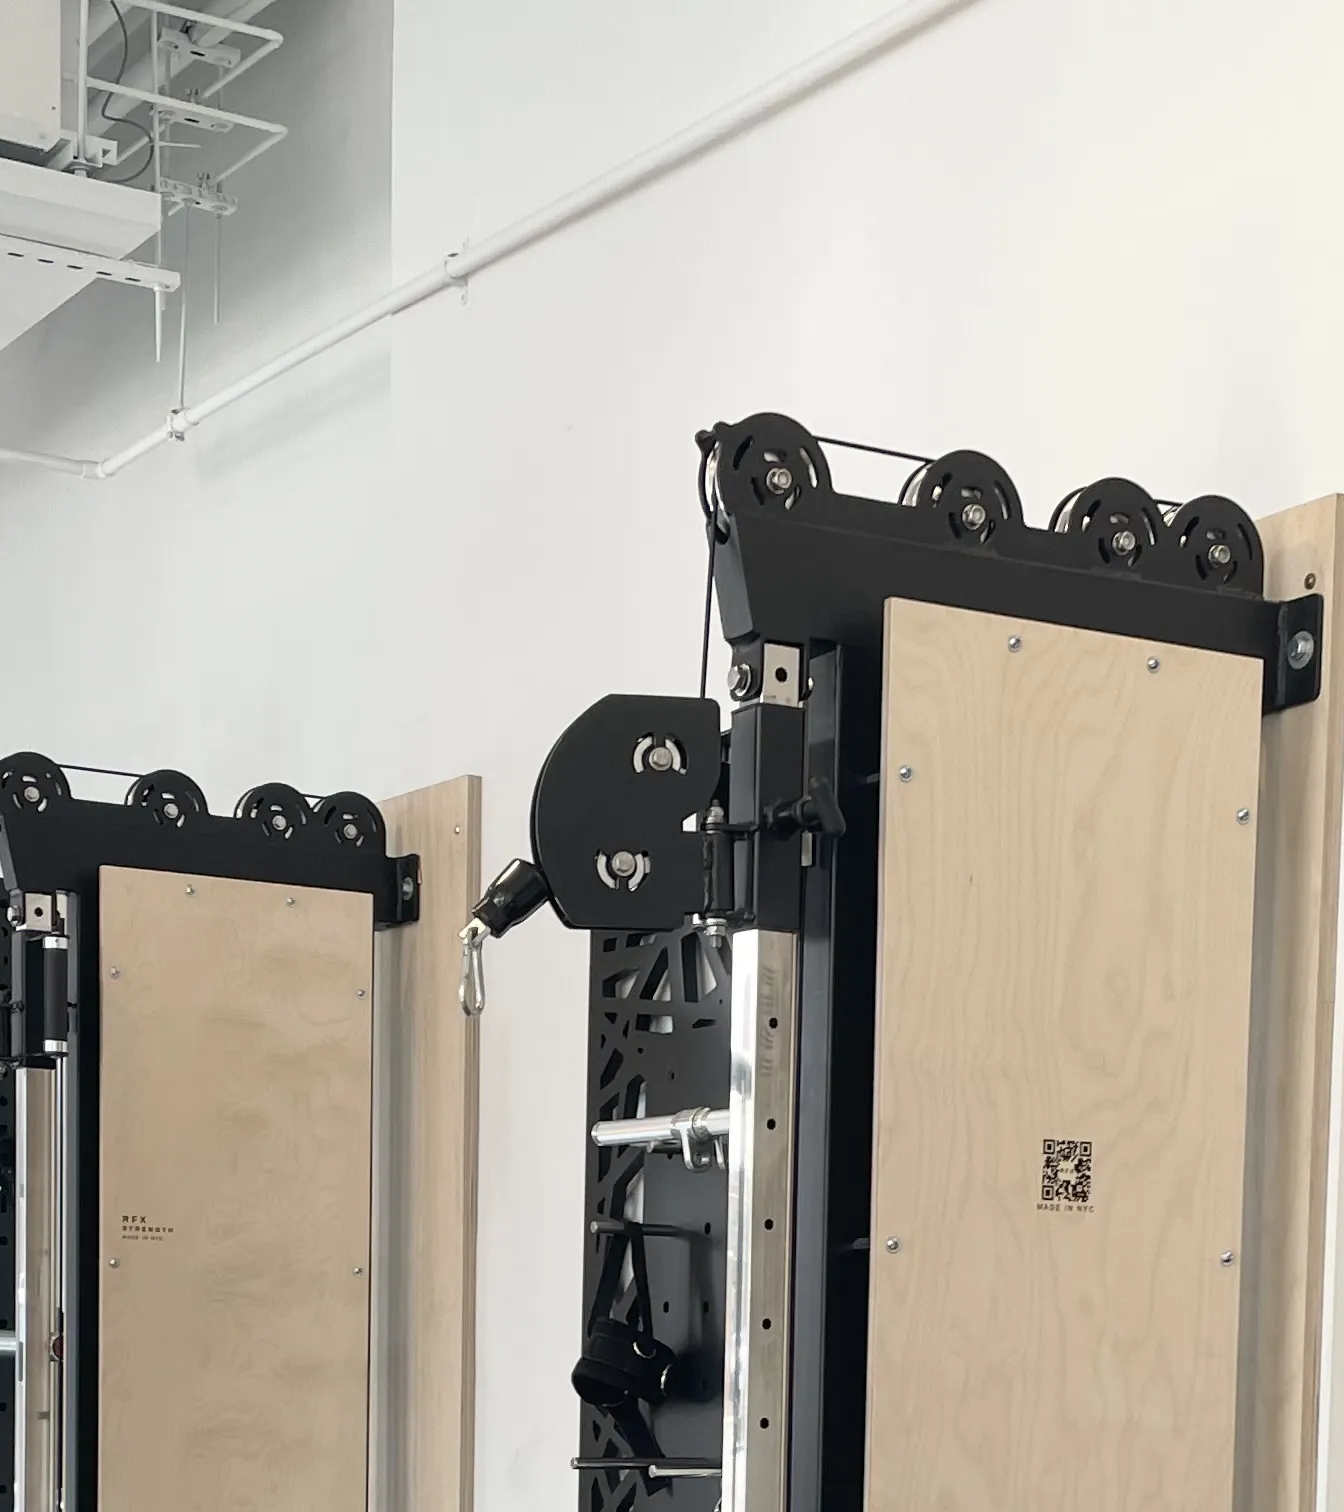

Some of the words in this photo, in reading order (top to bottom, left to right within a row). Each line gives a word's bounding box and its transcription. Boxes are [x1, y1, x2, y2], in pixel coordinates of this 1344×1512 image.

[1036, 1203, 1060, 1212] MADE
[1064, 1204, 1073, 1212] IN
[122, 1215, 147, 1224] RFX
[122, 1225, 174, 1233] STRENGTH
